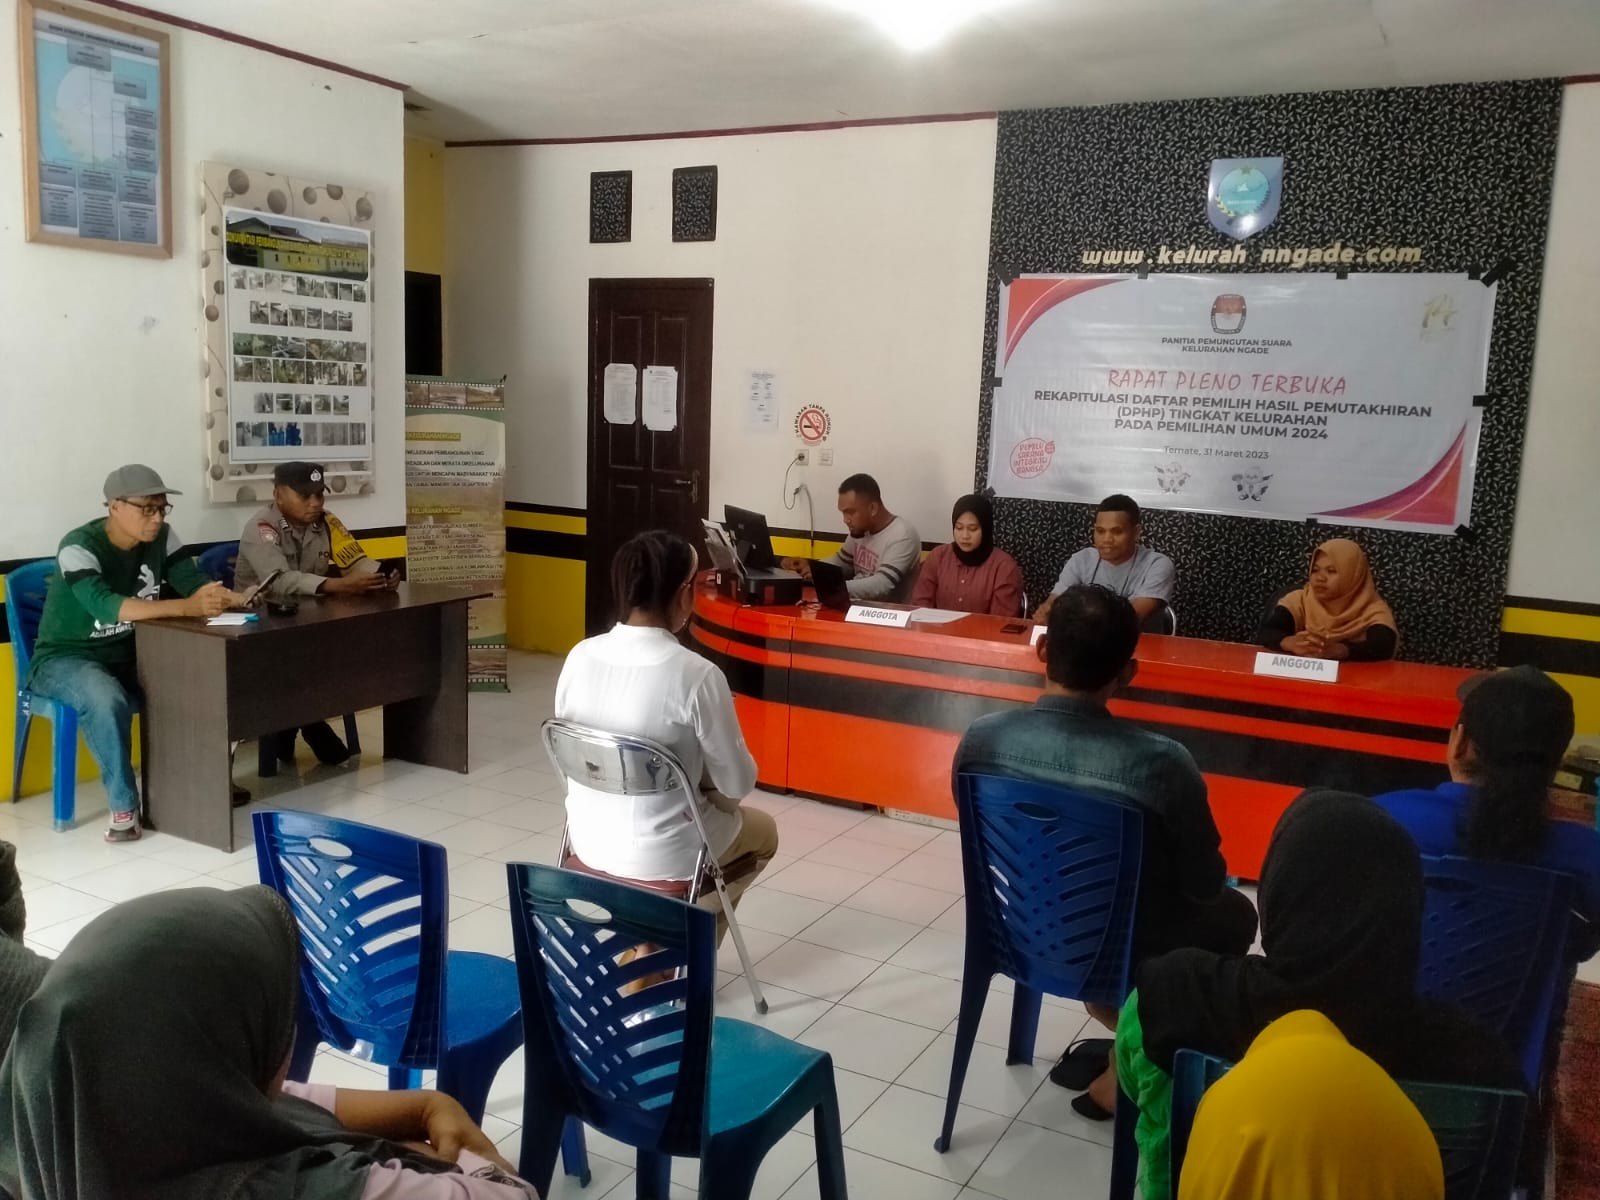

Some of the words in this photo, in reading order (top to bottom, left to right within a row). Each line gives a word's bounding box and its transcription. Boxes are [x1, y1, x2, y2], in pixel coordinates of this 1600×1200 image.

[1161, 337, 1196, 345] PANITIA
[1197, 338, 1260, 347] PEMUNGUTAN
[1261, 339, 1293, 347] SUARA
[1181, 345, 1236, 354] KELURAHAN
[1237, 346, 1270, 355] NGADE
[1108, 369, 1168, 388] RAPAT
[1176, 370, 1242, 391] PLENO
[1252, 373, 1347, 395] TERBUKA
[1034, 390, 1129, 405] REKAPITULASI
[1132, 394, 1188, 407] DAFTAR
[1192, 396, 1251, 410] PEMILIH
[1255, 399, 1300, 412] HASIL
[1303, 401, 1432, 418] PEMUTAKHIRAN
[1117, 406, 1166, 420] (DPHP)
[1169, 408, 1231, 423] TINGKAT
[1234, 411, 1328, 426] KELURAHAN
[1114, 418, 1153, 431] PADA
[1157, 421, 1236, 435] PEMILIHAN
[1240, 425, 1288, 438] UMUM
[1291, 427, 1328, 440] 2024
[1164, 446, 1202, 456] Ternate,
[1203, 448, 1213, 456] 31
[1215, 449, 1243, 458] Maret
[1245, 450, 1270, 460] 2023
[858, 609, 898, 622] ANGGOTA
[1271, 655, 1325, 672] ANGGOTA
